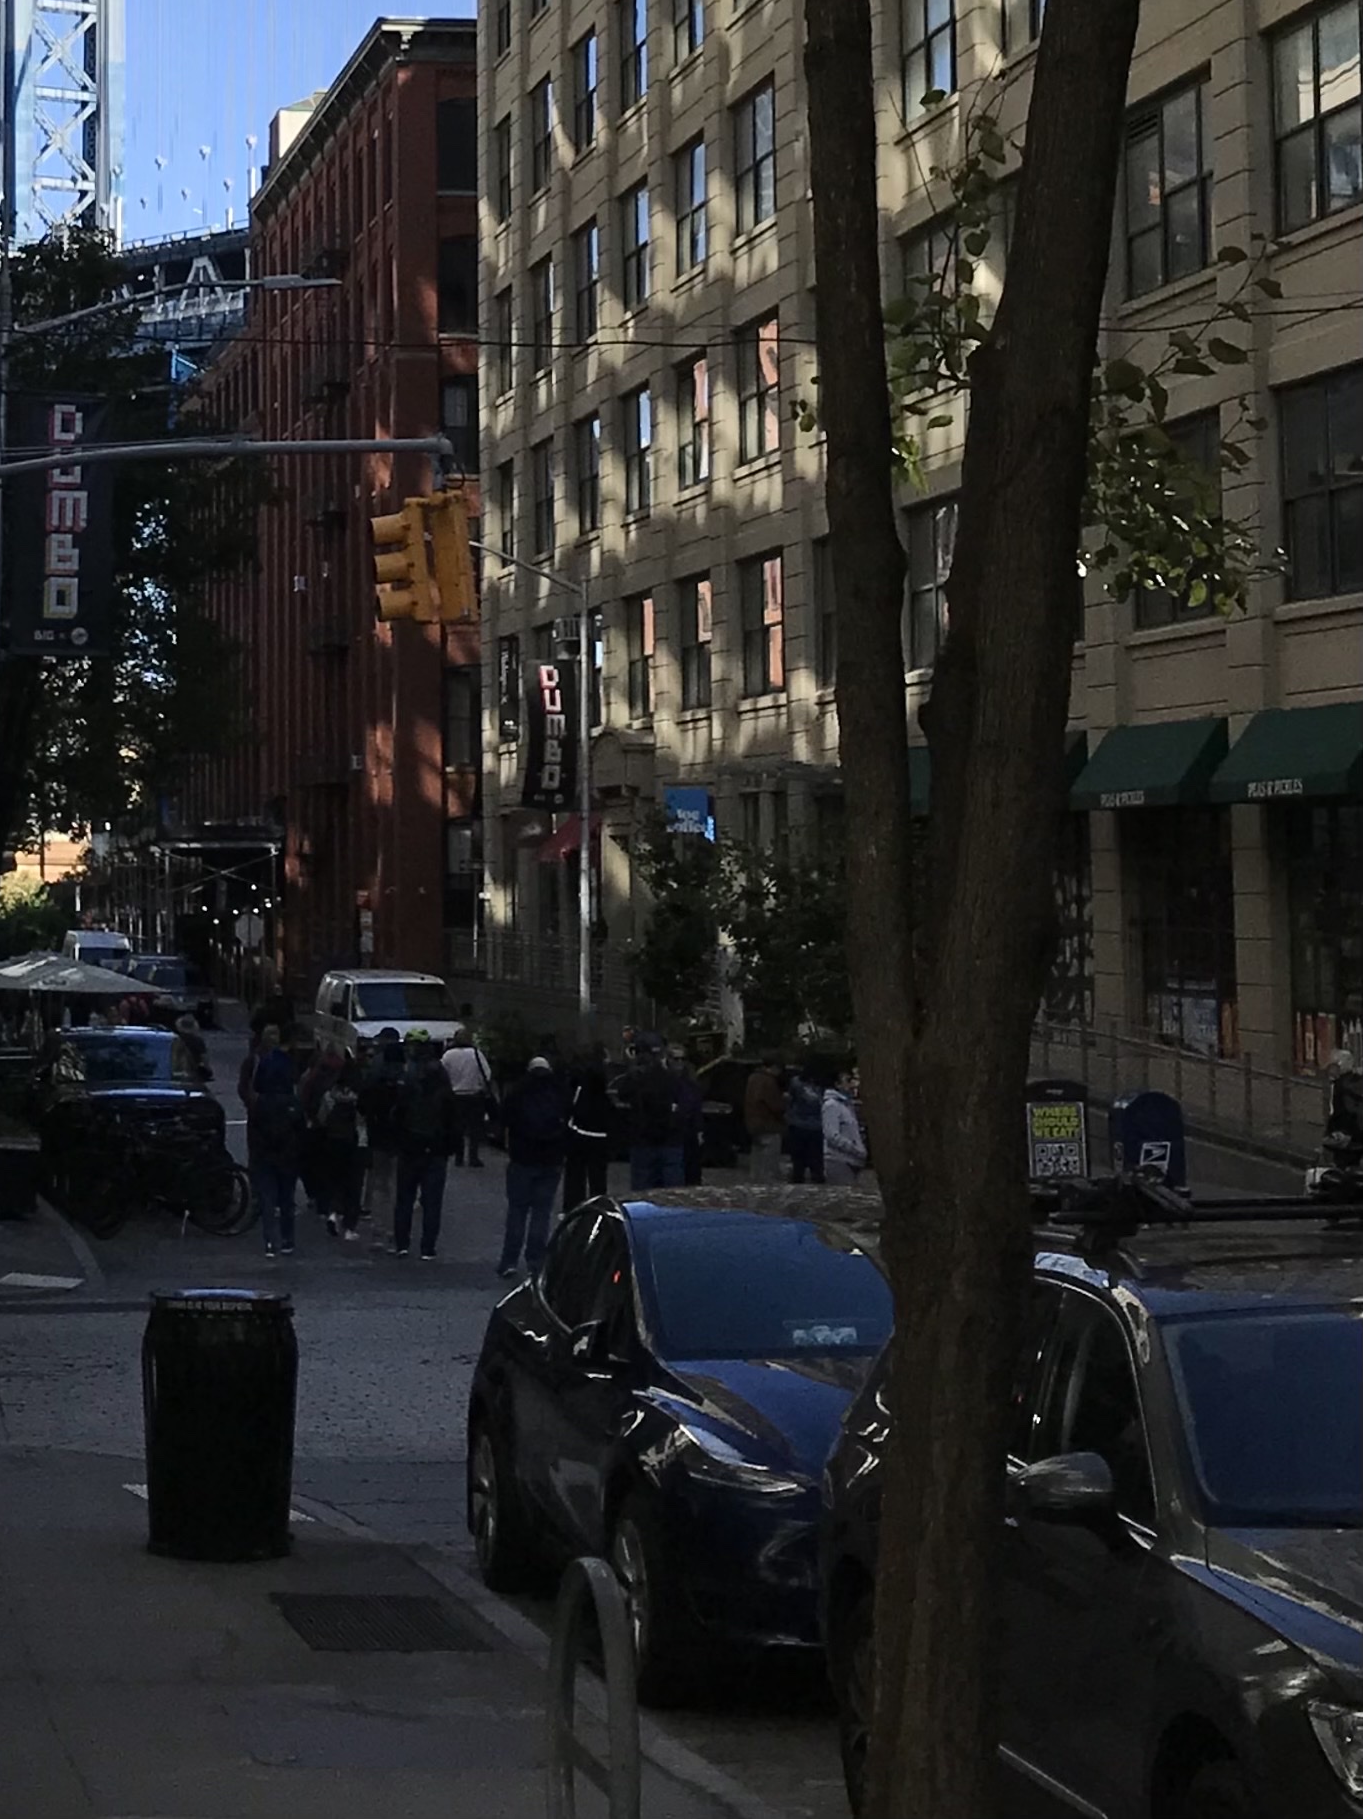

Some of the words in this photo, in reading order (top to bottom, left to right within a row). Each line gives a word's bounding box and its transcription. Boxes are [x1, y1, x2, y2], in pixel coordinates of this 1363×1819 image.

[44, 403, 89, 620] DUMBO
[539, 664, 567, 791] DUMBO
[1032, 1116, 1079, 1127] SHOULD
